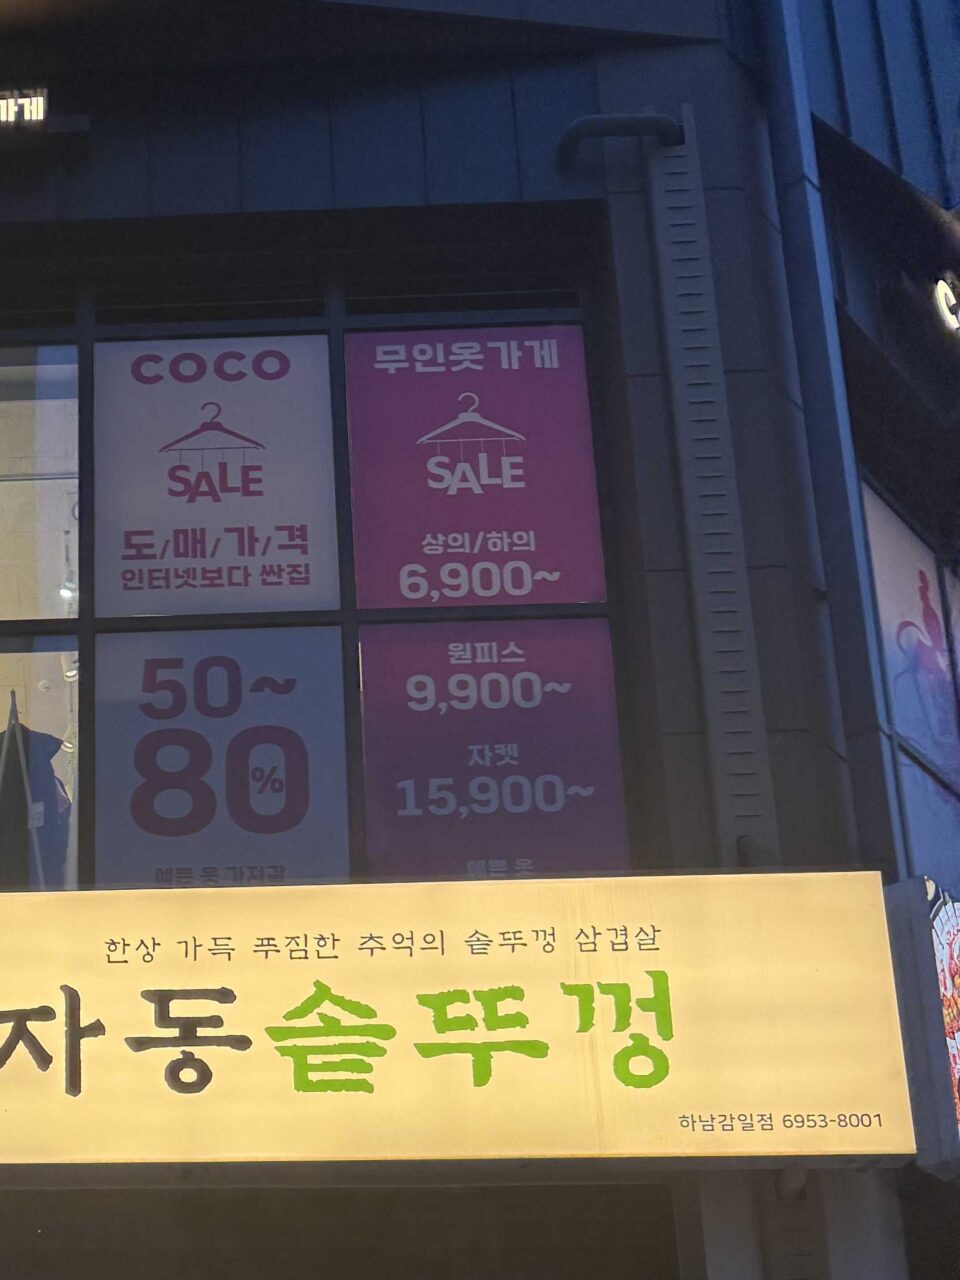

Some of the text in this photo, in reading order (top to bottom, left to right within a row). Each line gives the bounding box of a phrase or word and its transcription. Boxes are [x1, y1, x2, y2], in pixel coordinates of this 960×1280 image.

[130, 349, 291, 385] COCO
[374, 339, 560, 373] 무인옷가게
[167, 461, 264, 503] SALE
[426, 452, 526, 494] SALE
[120, 524, 310, 560] 도/매/가/격
[421, 530, 537, 555] 상의/하의
[120, 563, 311, 590] 인터넷보다 싼집
[399, 560, 561, 603] 6,900~
[447, 641, 526, 665] 원피스
[138, 655, 297, 719] 50~
[405, 671, 572, 714] 9,900~
[467, 744, 519, 766] 자켓
[395, 774, 595, 819] 15,900~
[104, 923, 661, 964] 한상 가득 푸짐한 추억의 솥뚜껑 삼겹살
[679, 1112, 883, 1132] 하남감일점 6953-8001
